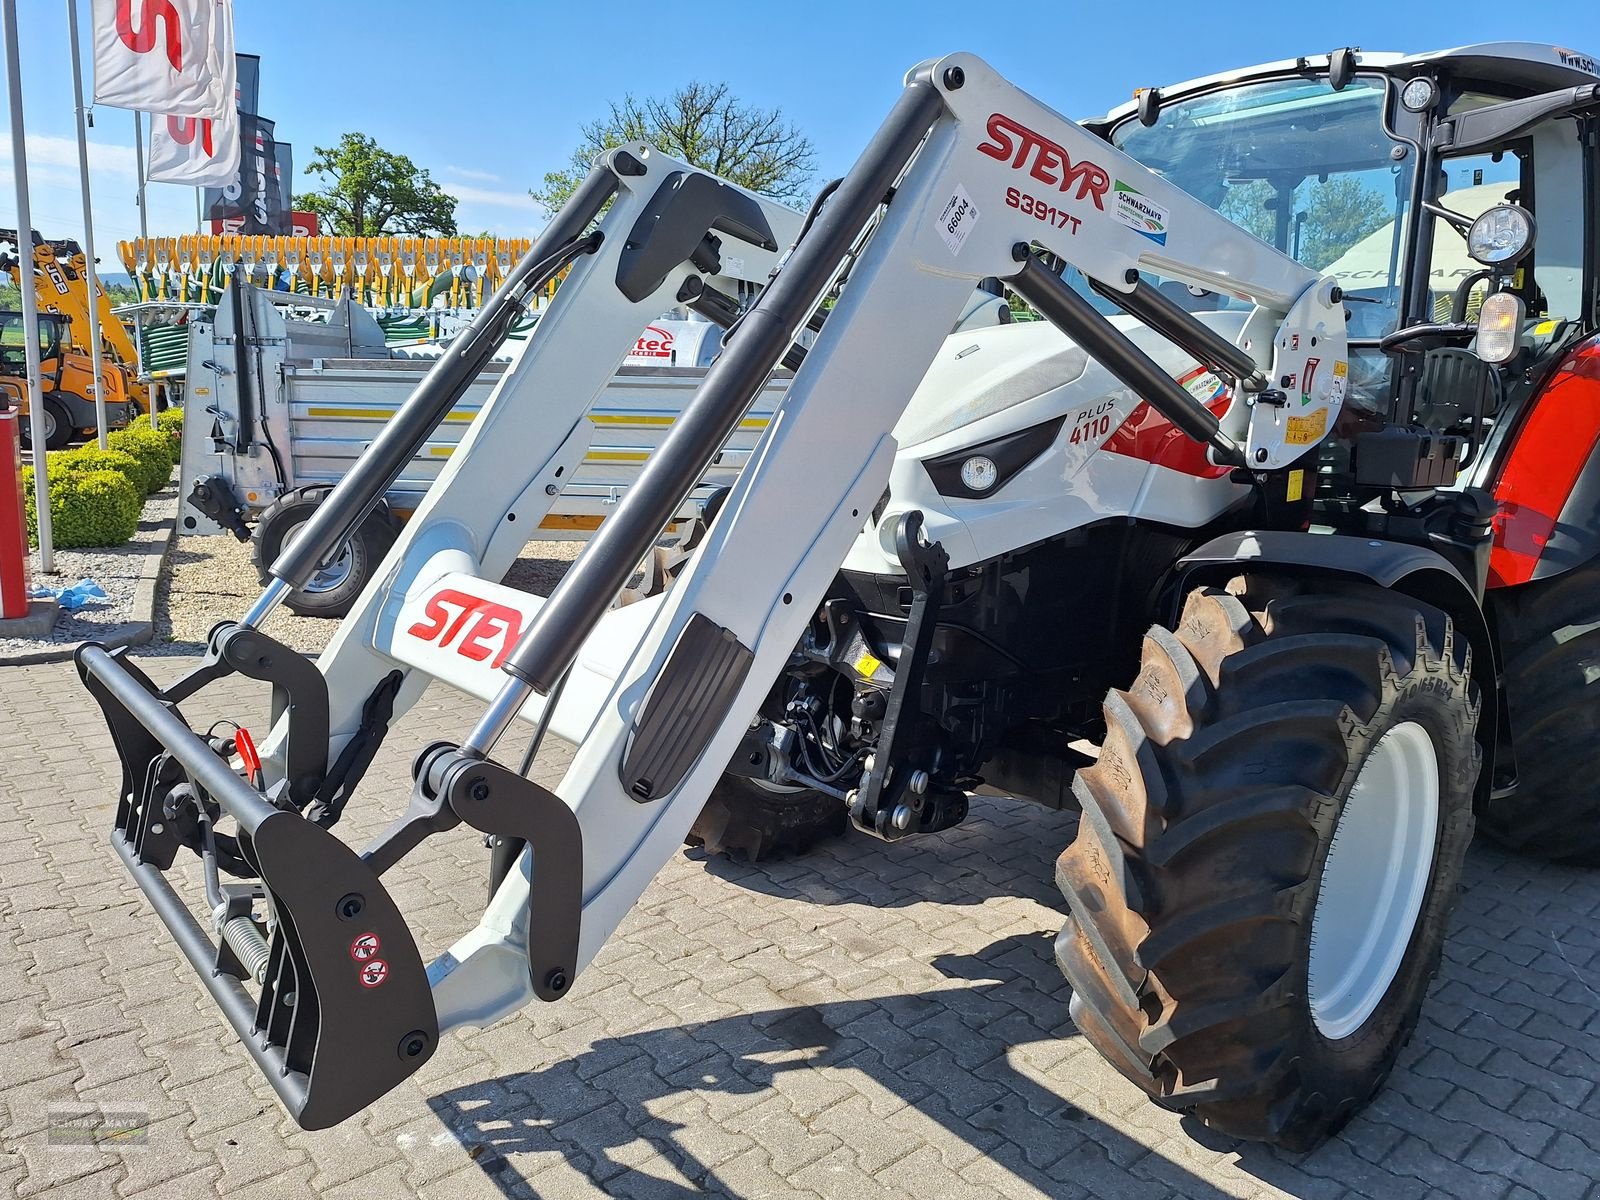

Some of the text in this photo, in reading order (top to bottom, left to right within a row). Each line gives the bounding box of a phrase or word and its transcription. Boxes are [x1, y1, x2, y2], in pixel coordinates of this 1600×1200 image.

[976, 112, 1111, 212] STEYR
[947, 198, 970, 234] 66004
[1004, 186, 1083, 236] S3917T
[1118, 191, 1163, 222] SCHWARZMAYR
[45, 263, 69, 294] JCB
[1334, 268, 1476, 280] SCHAR
[633, 338, 674, 351] tec
[1076, 399, 1116, 424] PLUS
[1069, 415, 1111, 446] 4110
[407, 588, 526, 670] STEY
